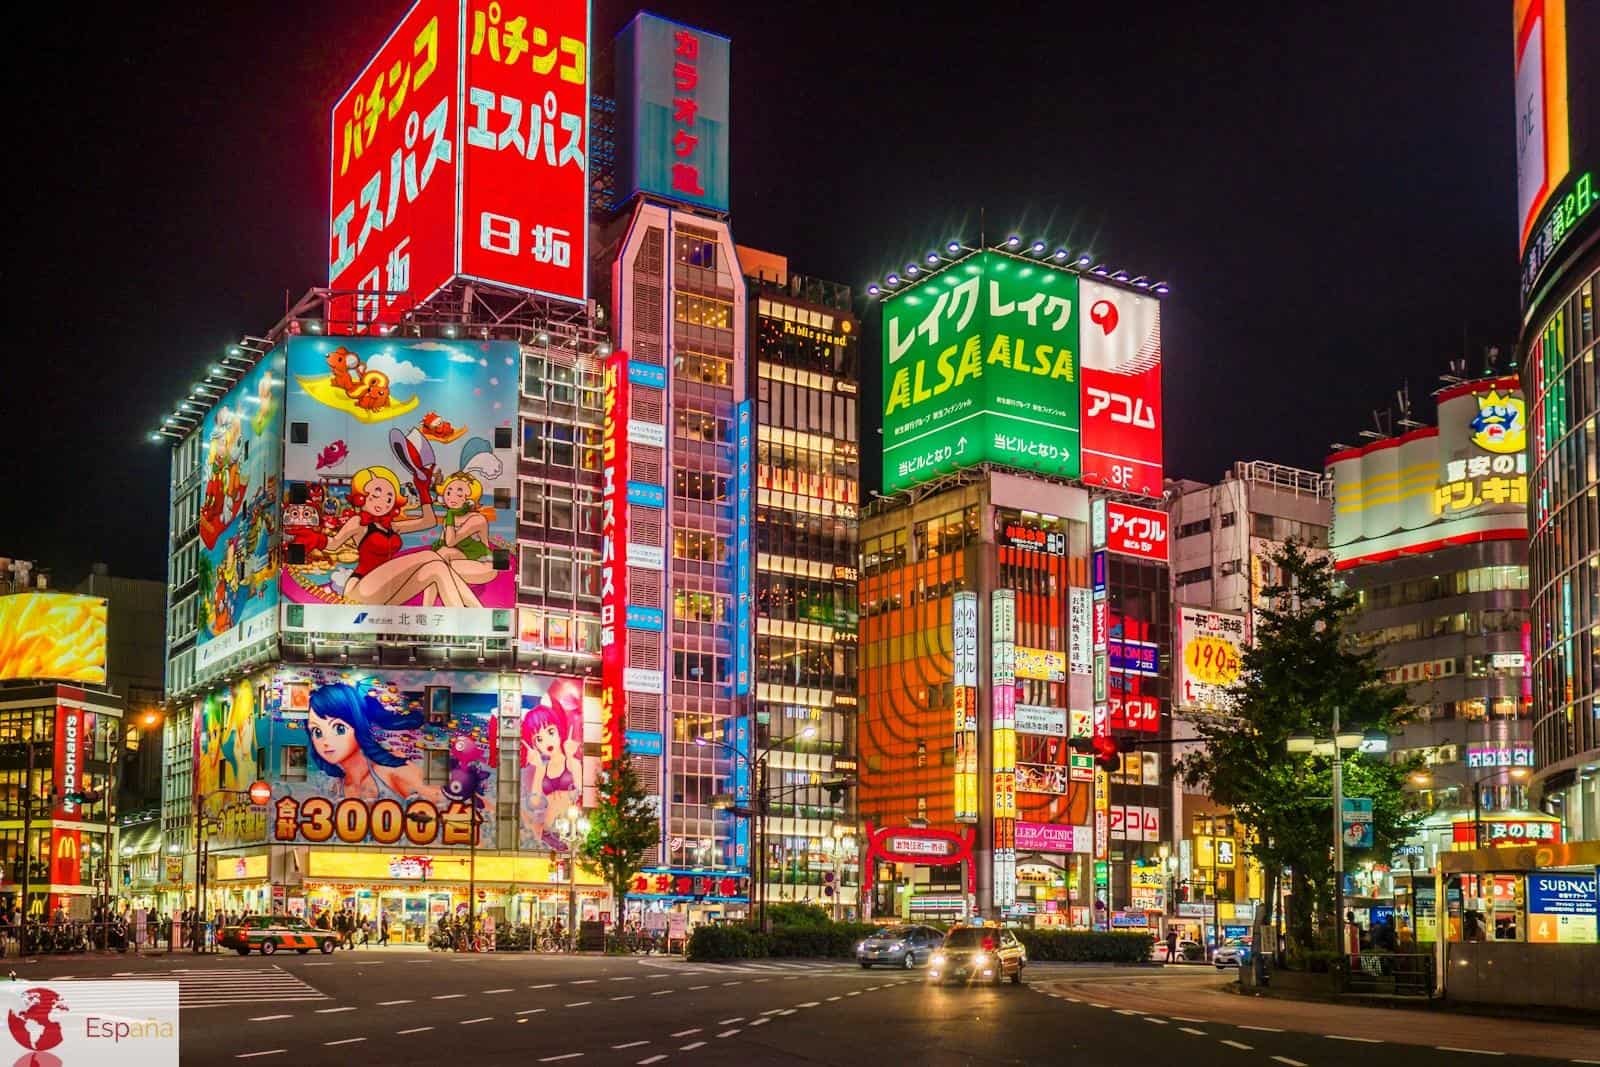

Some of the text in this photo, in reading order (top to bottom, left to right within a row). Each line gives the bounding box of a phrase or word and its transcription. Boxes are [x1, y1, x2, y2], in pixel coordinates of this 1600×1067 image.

[471, 1, 586, 86] パチンコ
[341, 16, 438, 177] パチンコ
[467, 87, 585, 171] エスパス
[331, 96, 452, 282] エスパス
[889, 276, 980, 364] レイク
[989, 280, 1072, 332] レイク
[886, 335, 983, 416] ALSA
[986, 334, 1074, 383] ALSA
[1087, 387, 1156, 429] アコム
[898, 446, 952, 477] 当ビルとなり
[994, 433, 1059, 459] 当ビルとなり
[1111, 465, 1134, 485] 3F
[1108, 511, 1166, 542] アイフル
[397, 612, 447, 626] 北電子
[955, 607, 965, 675] 小松ビル
[965, 607, 976, 675] 小松ビル
[1109, 698, 1156, 720] アイフル
[1110, 810, 1157, 831] アコム
[1538, 920, 1550, 938] 4
